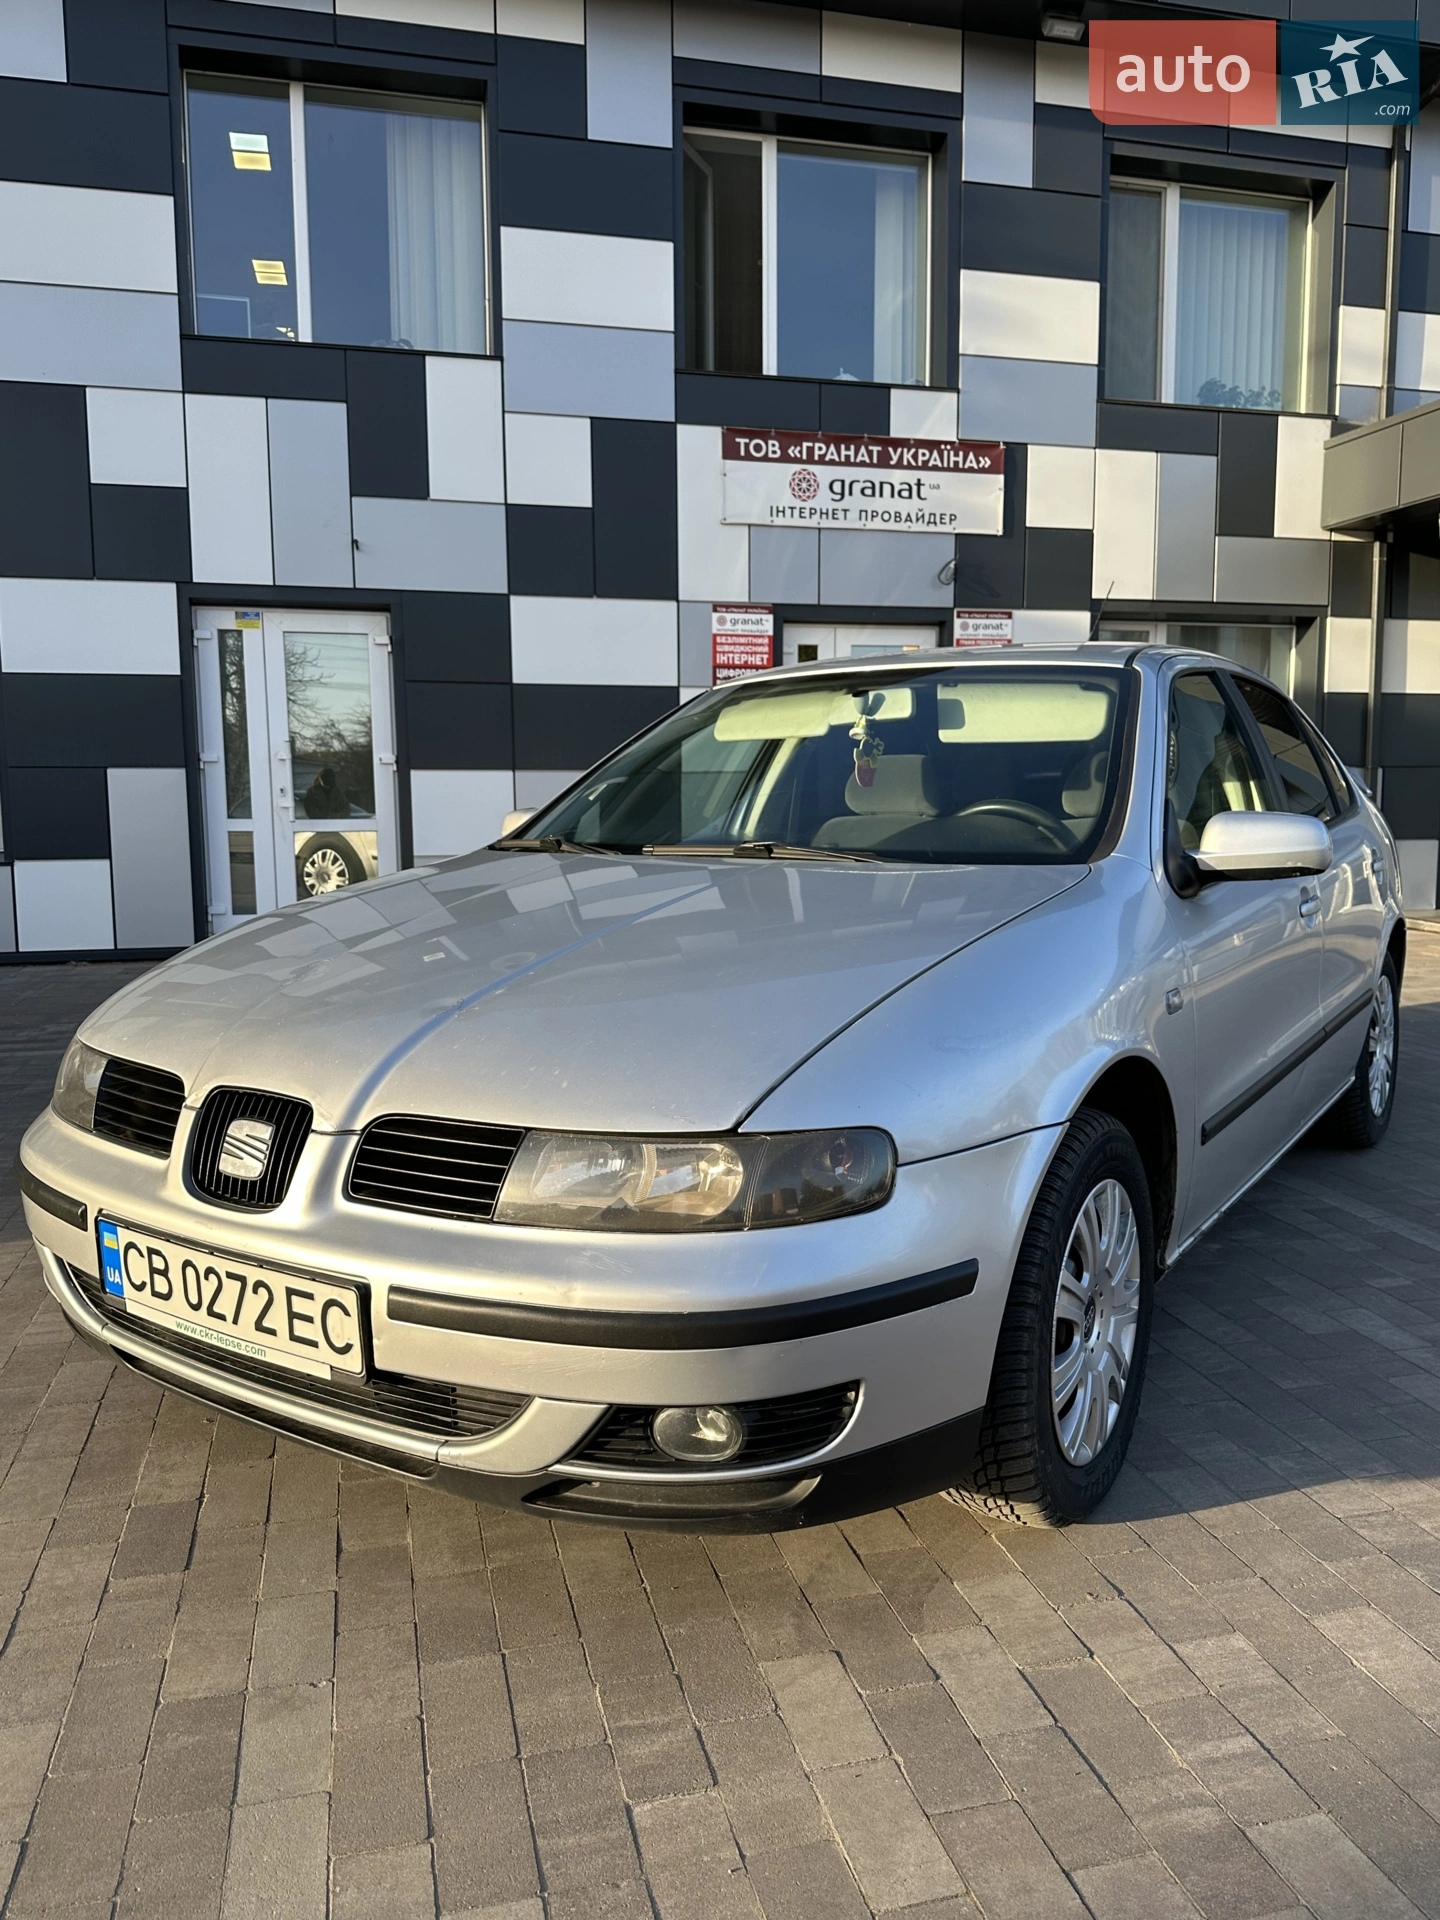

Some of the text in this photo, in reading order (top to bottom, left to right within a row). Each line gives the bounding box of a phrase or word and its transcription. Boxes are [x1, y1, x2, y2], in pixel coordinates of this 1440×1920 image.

[735, 437, 992, 470] ТОВ «ГРАНАТ УКРАЇНА»
[828, 477, 927, 502] granat
[769, 505, 958, 527] ІНТЕРНЕТ ПРОВАЙДЕР
[729, 617, 764, 627] granat
[971, 621, 1004, 632] granat
[716, 653, 769, 665] ІНТЕРНЕТ
[106, 1266, 123, 1286] UA
[122, 1240, 355, 1356] CB 0272 EC
[175, 1319, 267, 1359] www.ckr-lepse.com
